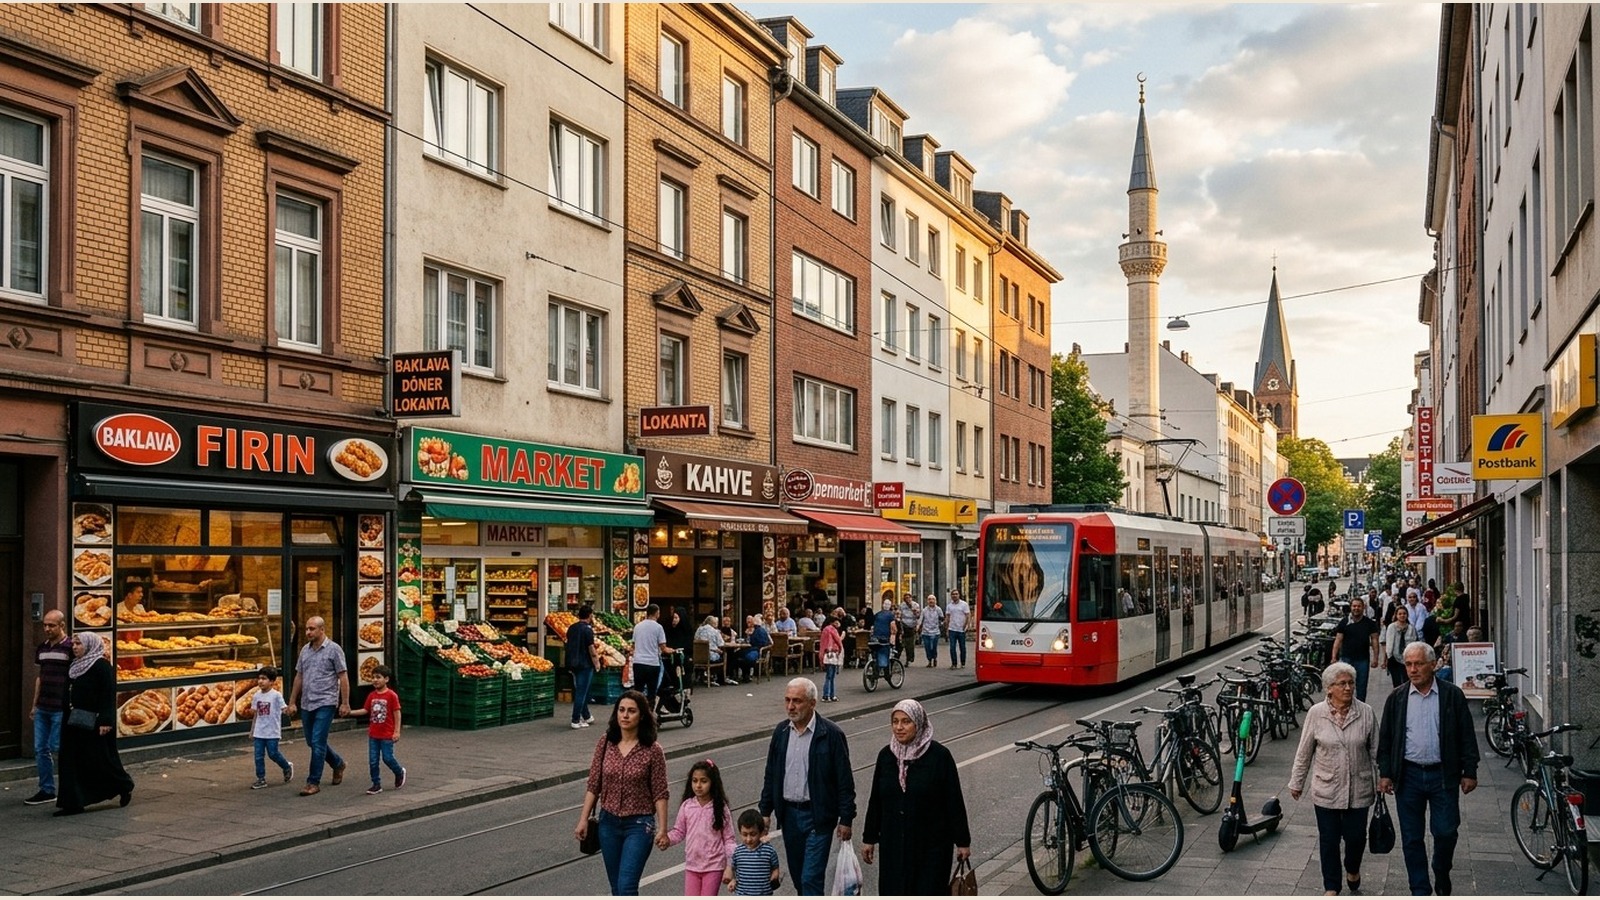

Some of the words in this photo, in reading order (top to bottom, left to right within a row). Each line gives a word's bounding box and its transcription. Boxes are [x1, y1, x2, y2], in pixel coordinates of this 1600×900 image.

[395, 357, 450, 373] BAKLAVA
[394, 396, 450, 411] LOKANTA
[642, 413, 707, 431] LOKANTA
[102, 426, 176, 452] BAKLAVA
[196, 424, 316, 475] FIRIN
[480, 444, 606, 490] MARKET
[1478, 456, 1537, 469] Postbank
[686, 462, 752, 496] KAHVE
[487, 524, 543, 543] MARKET
